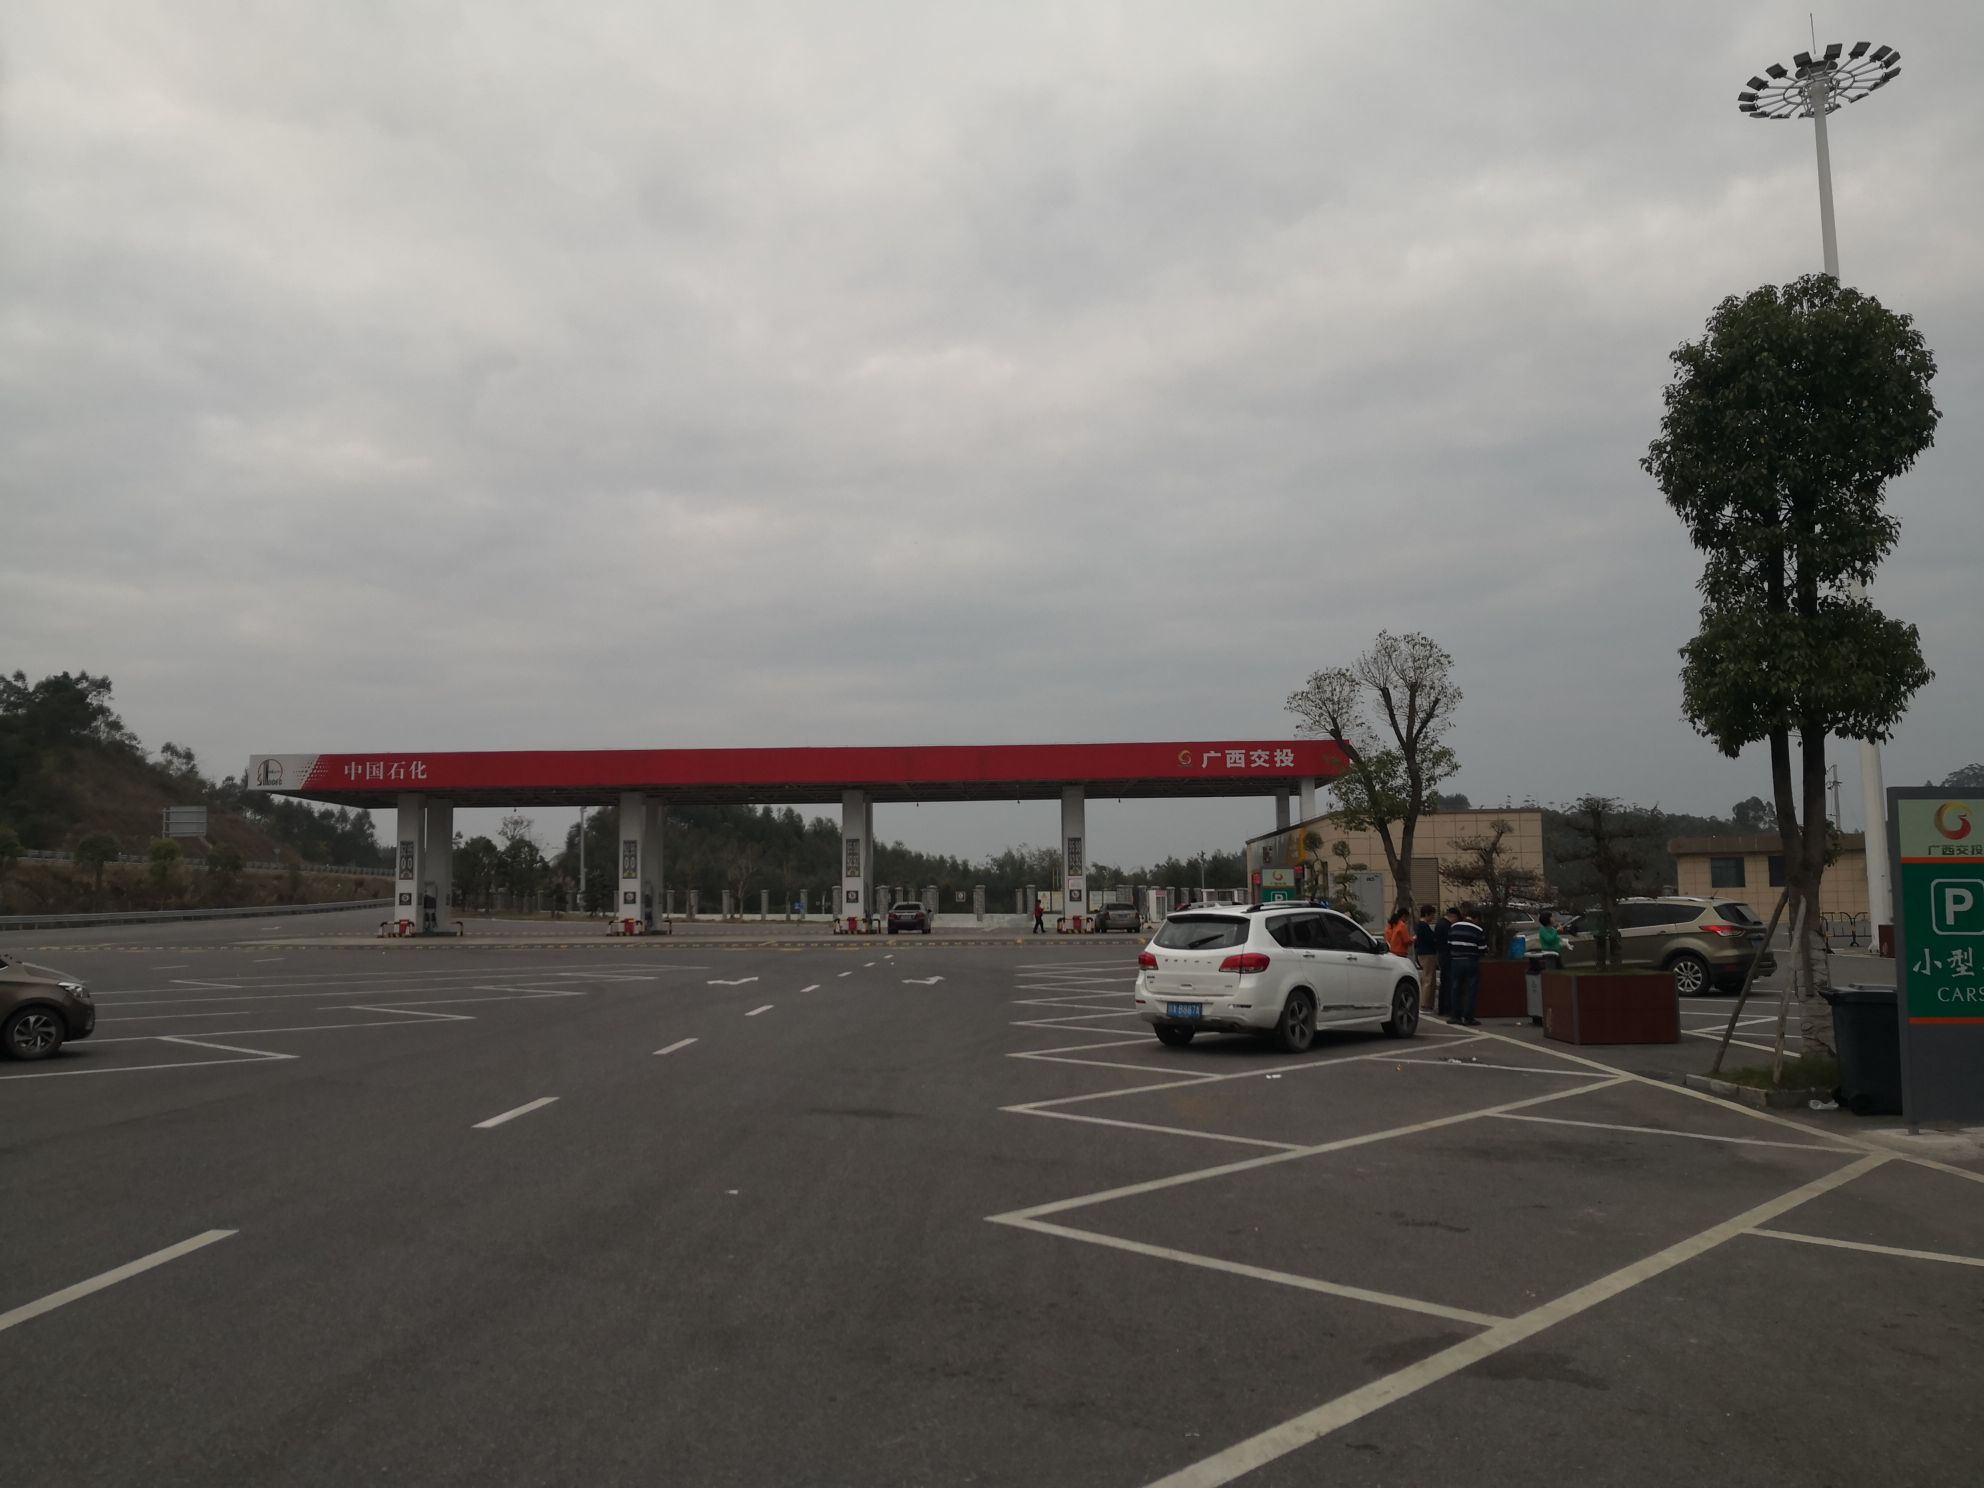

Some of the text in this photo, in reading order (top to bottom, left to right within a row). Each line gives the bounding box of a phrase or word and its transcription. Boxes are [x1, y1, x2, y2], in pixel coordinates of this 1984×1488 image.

[1201, 748, 1295, 769] 广西交投
[344, 760, 428, 781] 中国石化
[1927, 844, 1984, 856] 广西交投
[1945, 887, 1974, 925] P
[1912, 946, 1984, 978] 小型
